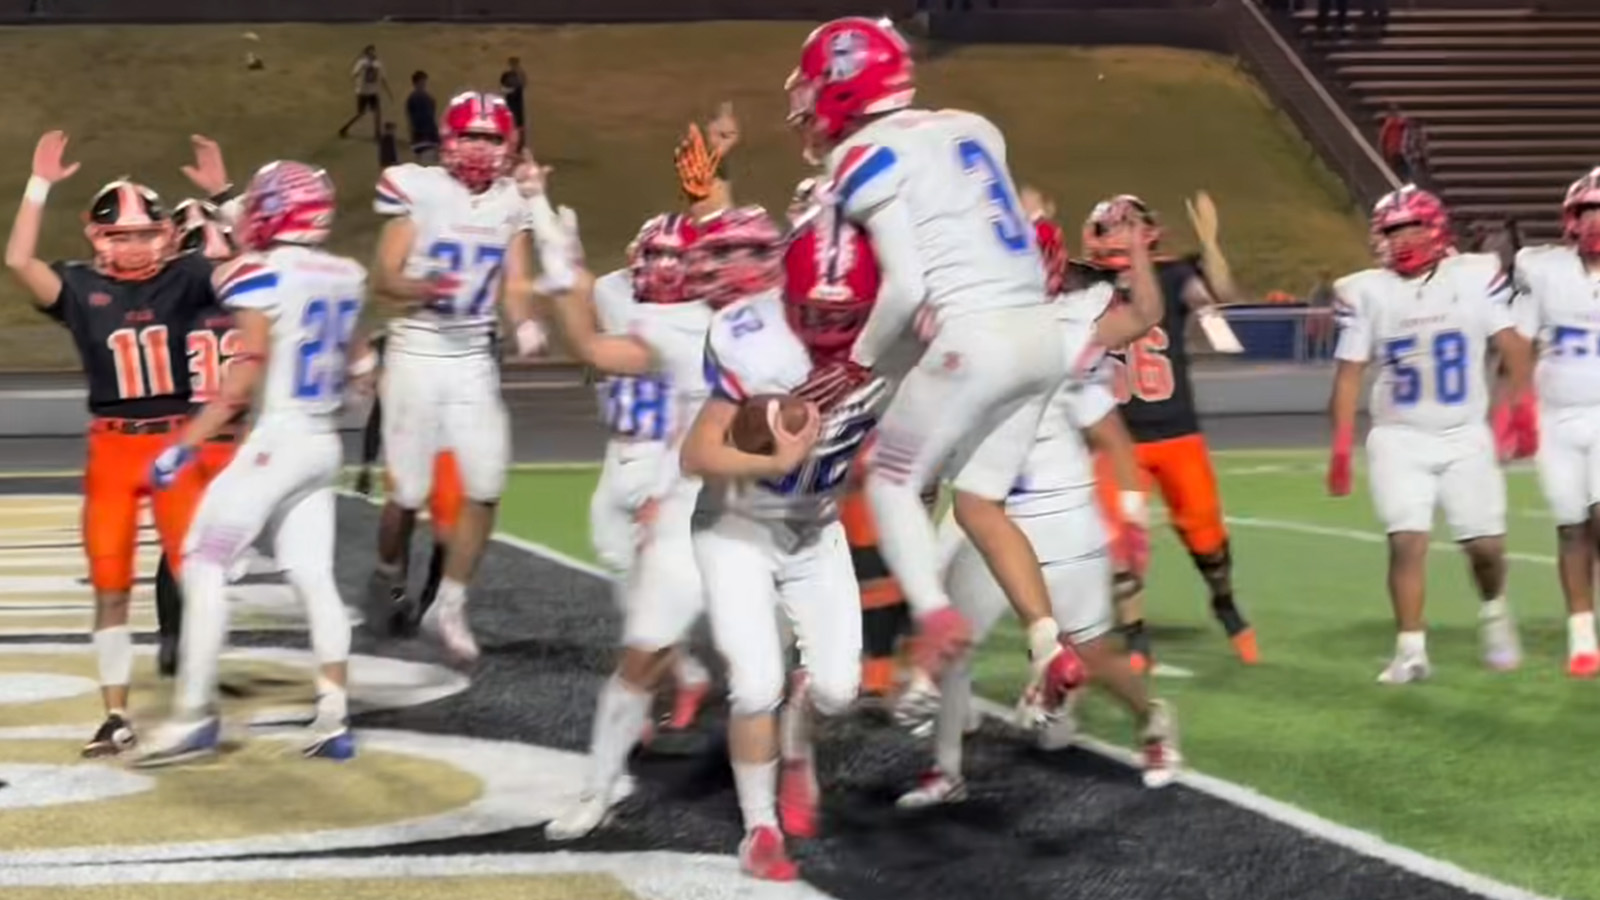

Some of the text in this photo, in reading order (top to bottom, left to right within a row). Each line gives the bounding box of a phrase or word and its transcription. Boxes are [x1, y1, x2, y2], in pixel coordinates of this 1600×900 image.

[956, 136, 1030, 254] 3
[107, 324, 174, 399] 11
[1385, 331, 1469, 405] 58
